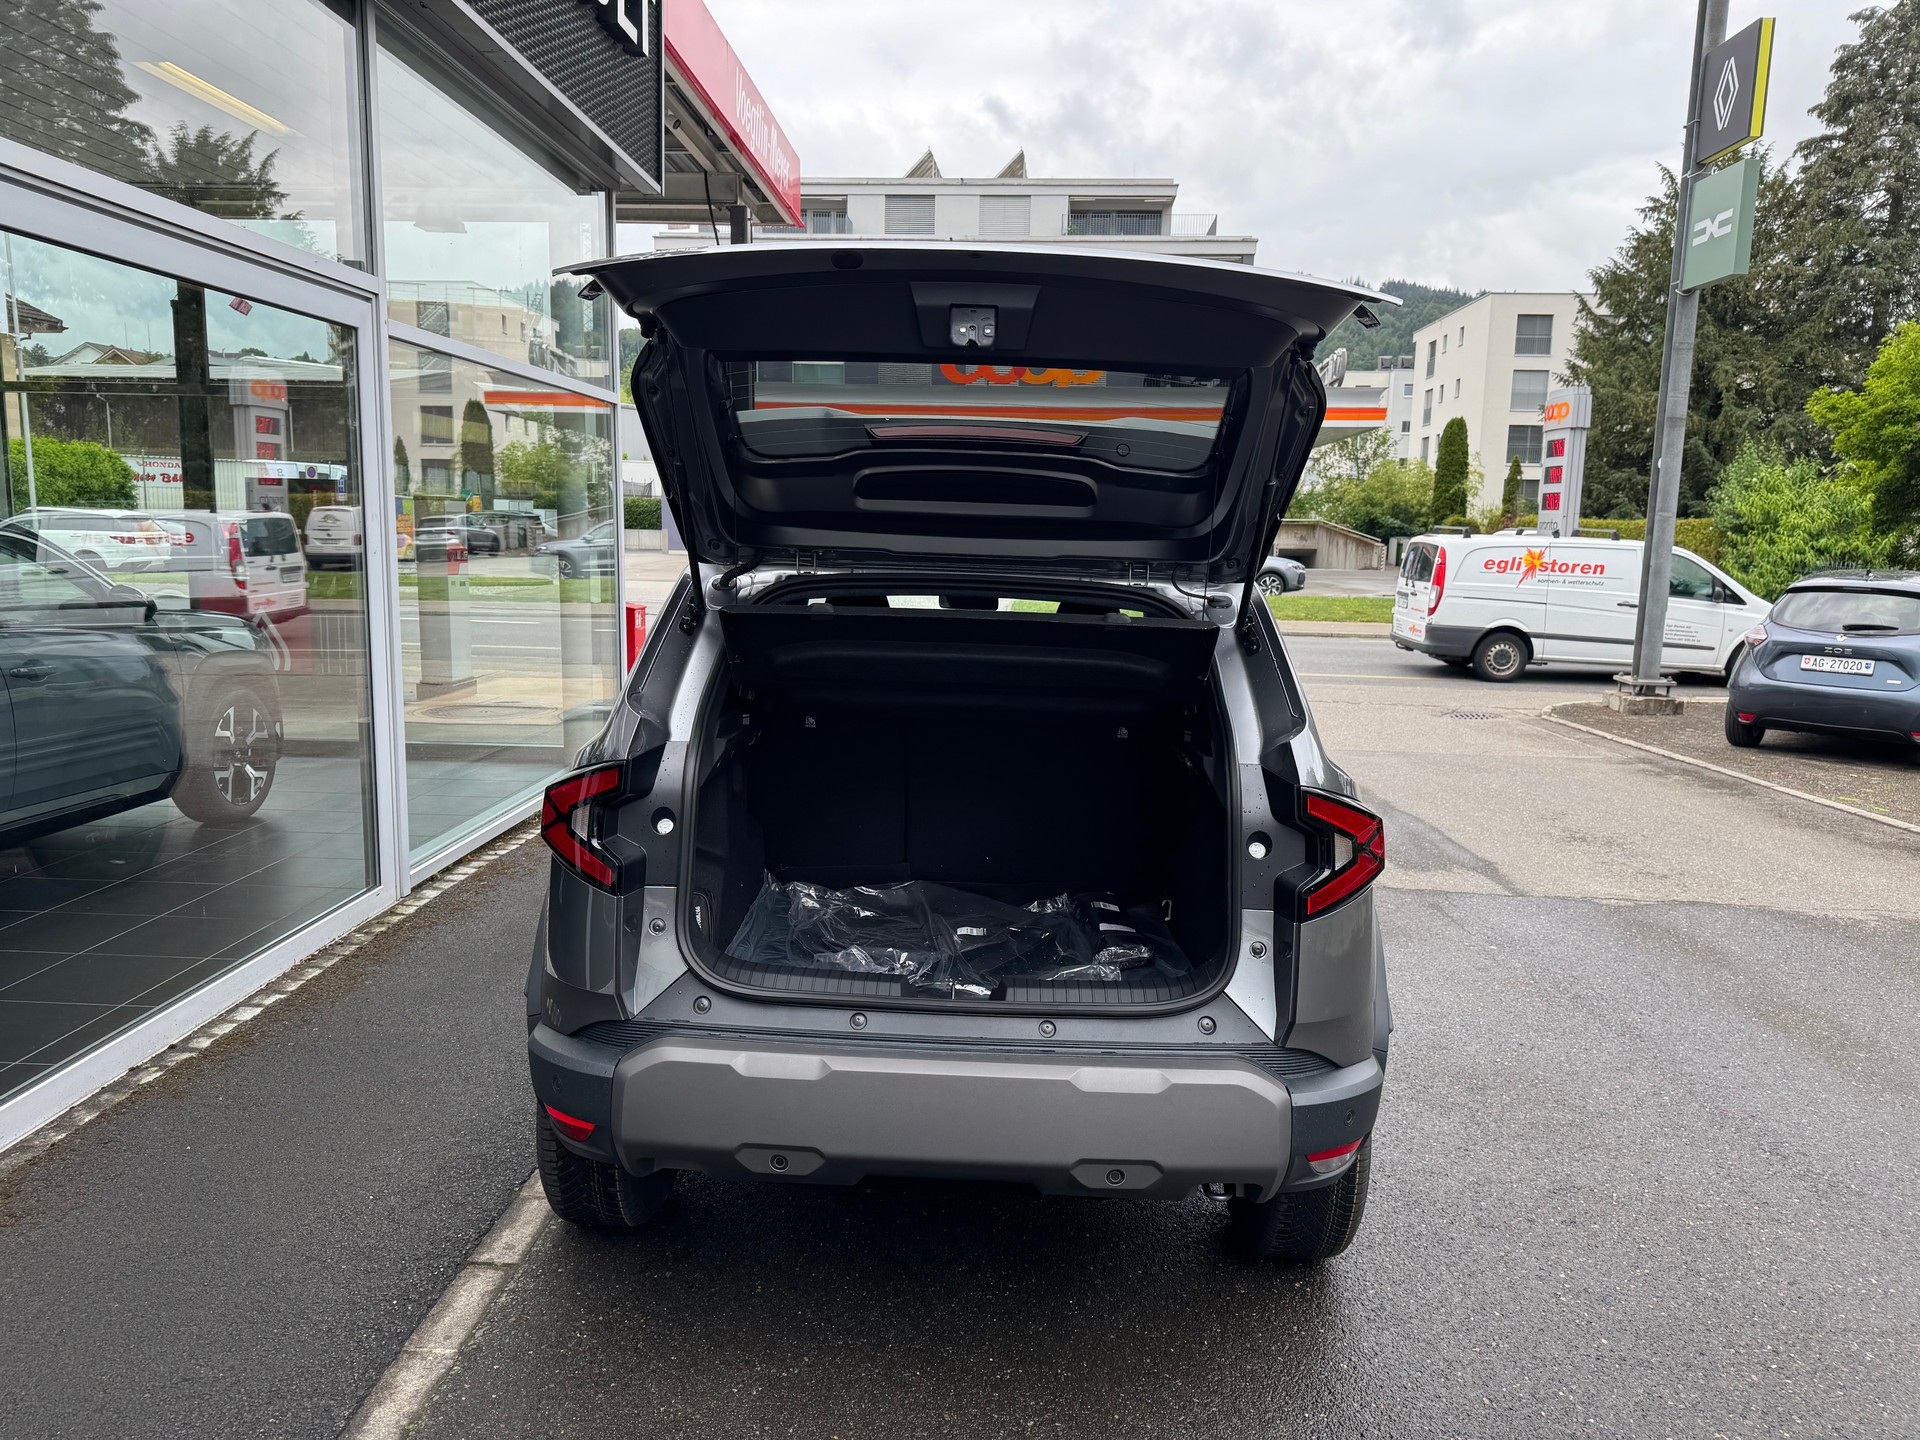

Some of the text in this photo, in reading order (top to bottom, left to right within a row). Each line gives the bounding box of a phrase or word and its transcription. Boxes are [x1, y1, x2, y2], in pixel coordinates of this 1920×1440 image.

[1484, 557, 1606, 575] egli storen
[1824, 646, 1853, 655] ZOE
